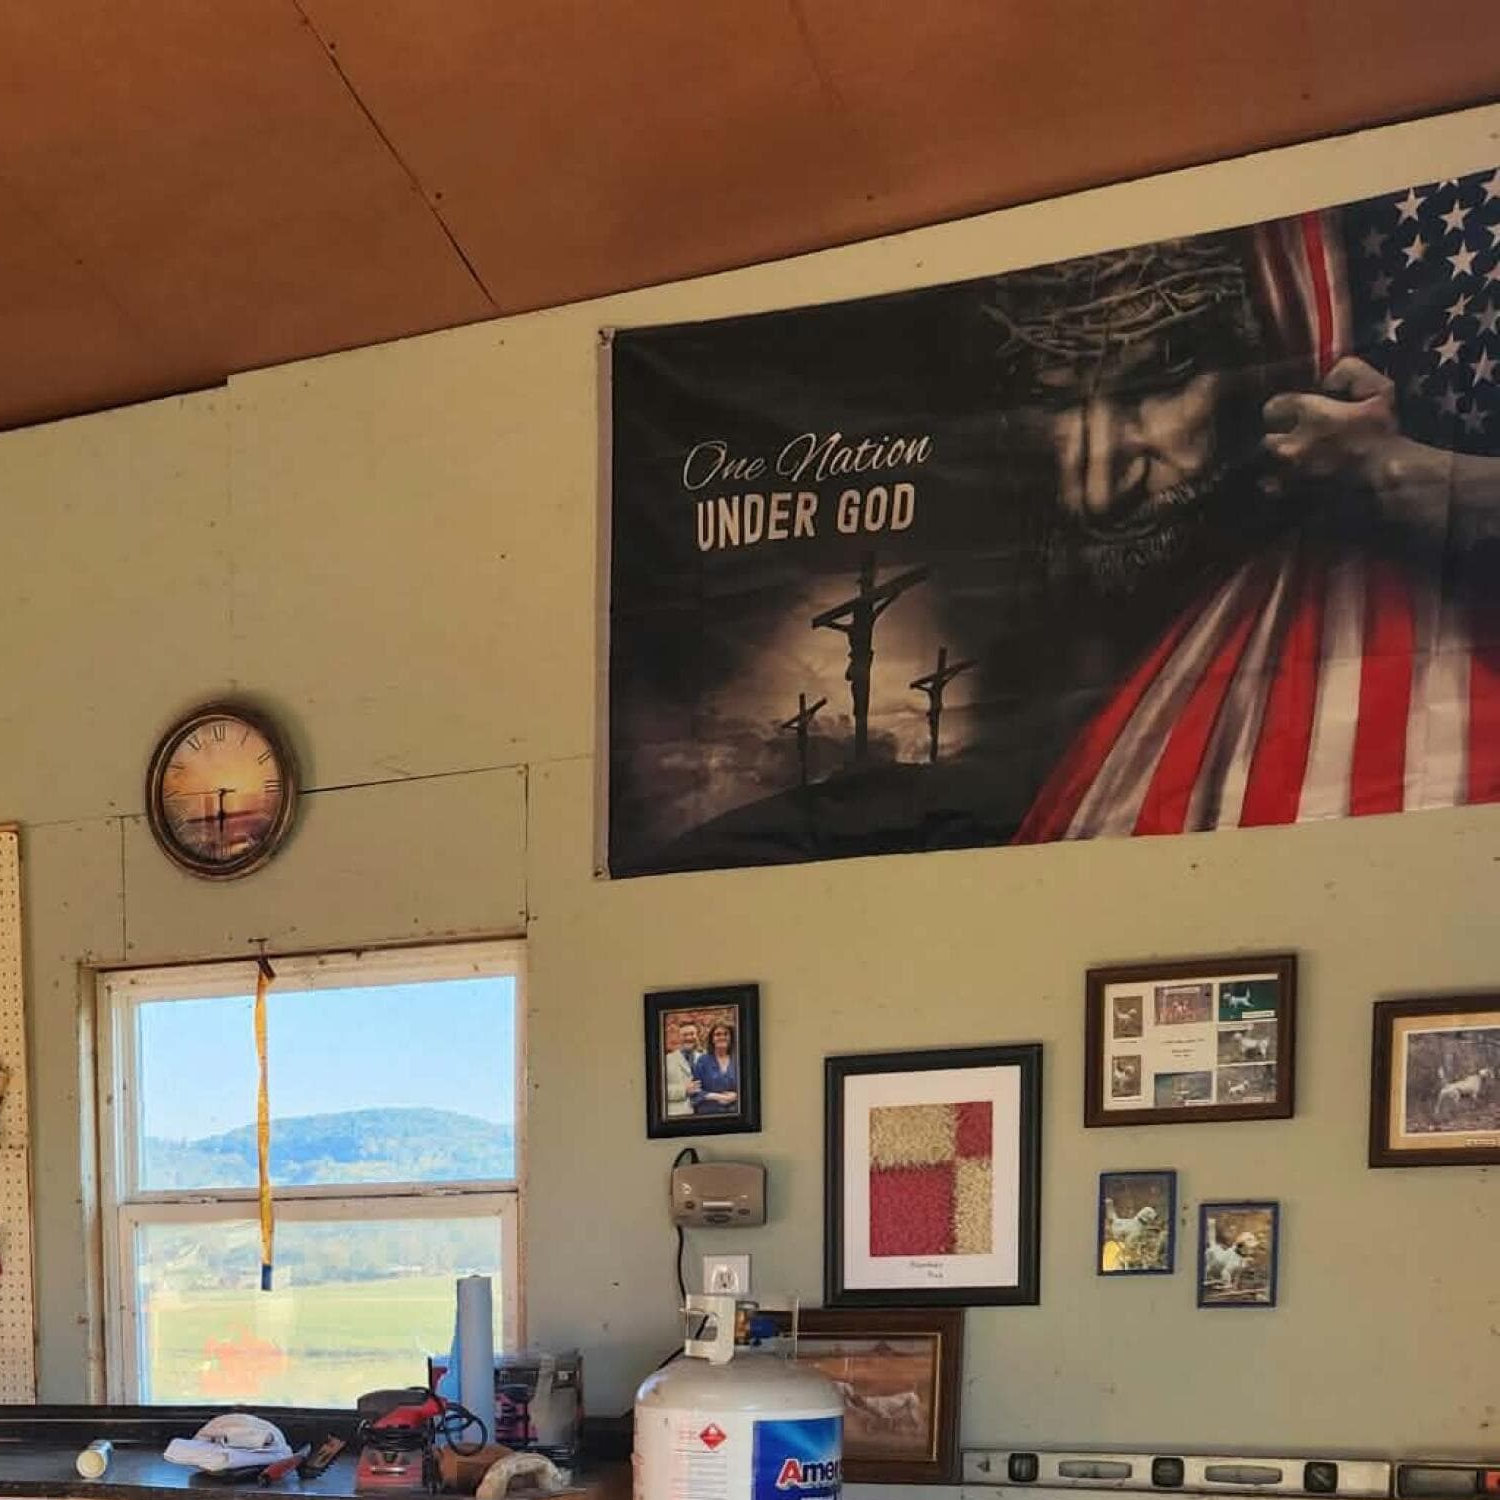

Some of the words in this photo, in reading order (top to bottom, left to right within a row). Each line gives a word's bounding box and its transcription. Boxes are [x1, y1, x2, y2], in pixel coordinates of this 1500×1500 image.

[683, 440, 767, 491] One
[775, 431, 934, 483] Nation
[697, 491, 816, 552] UNDER
[836, 482, 915, 535] GOD
